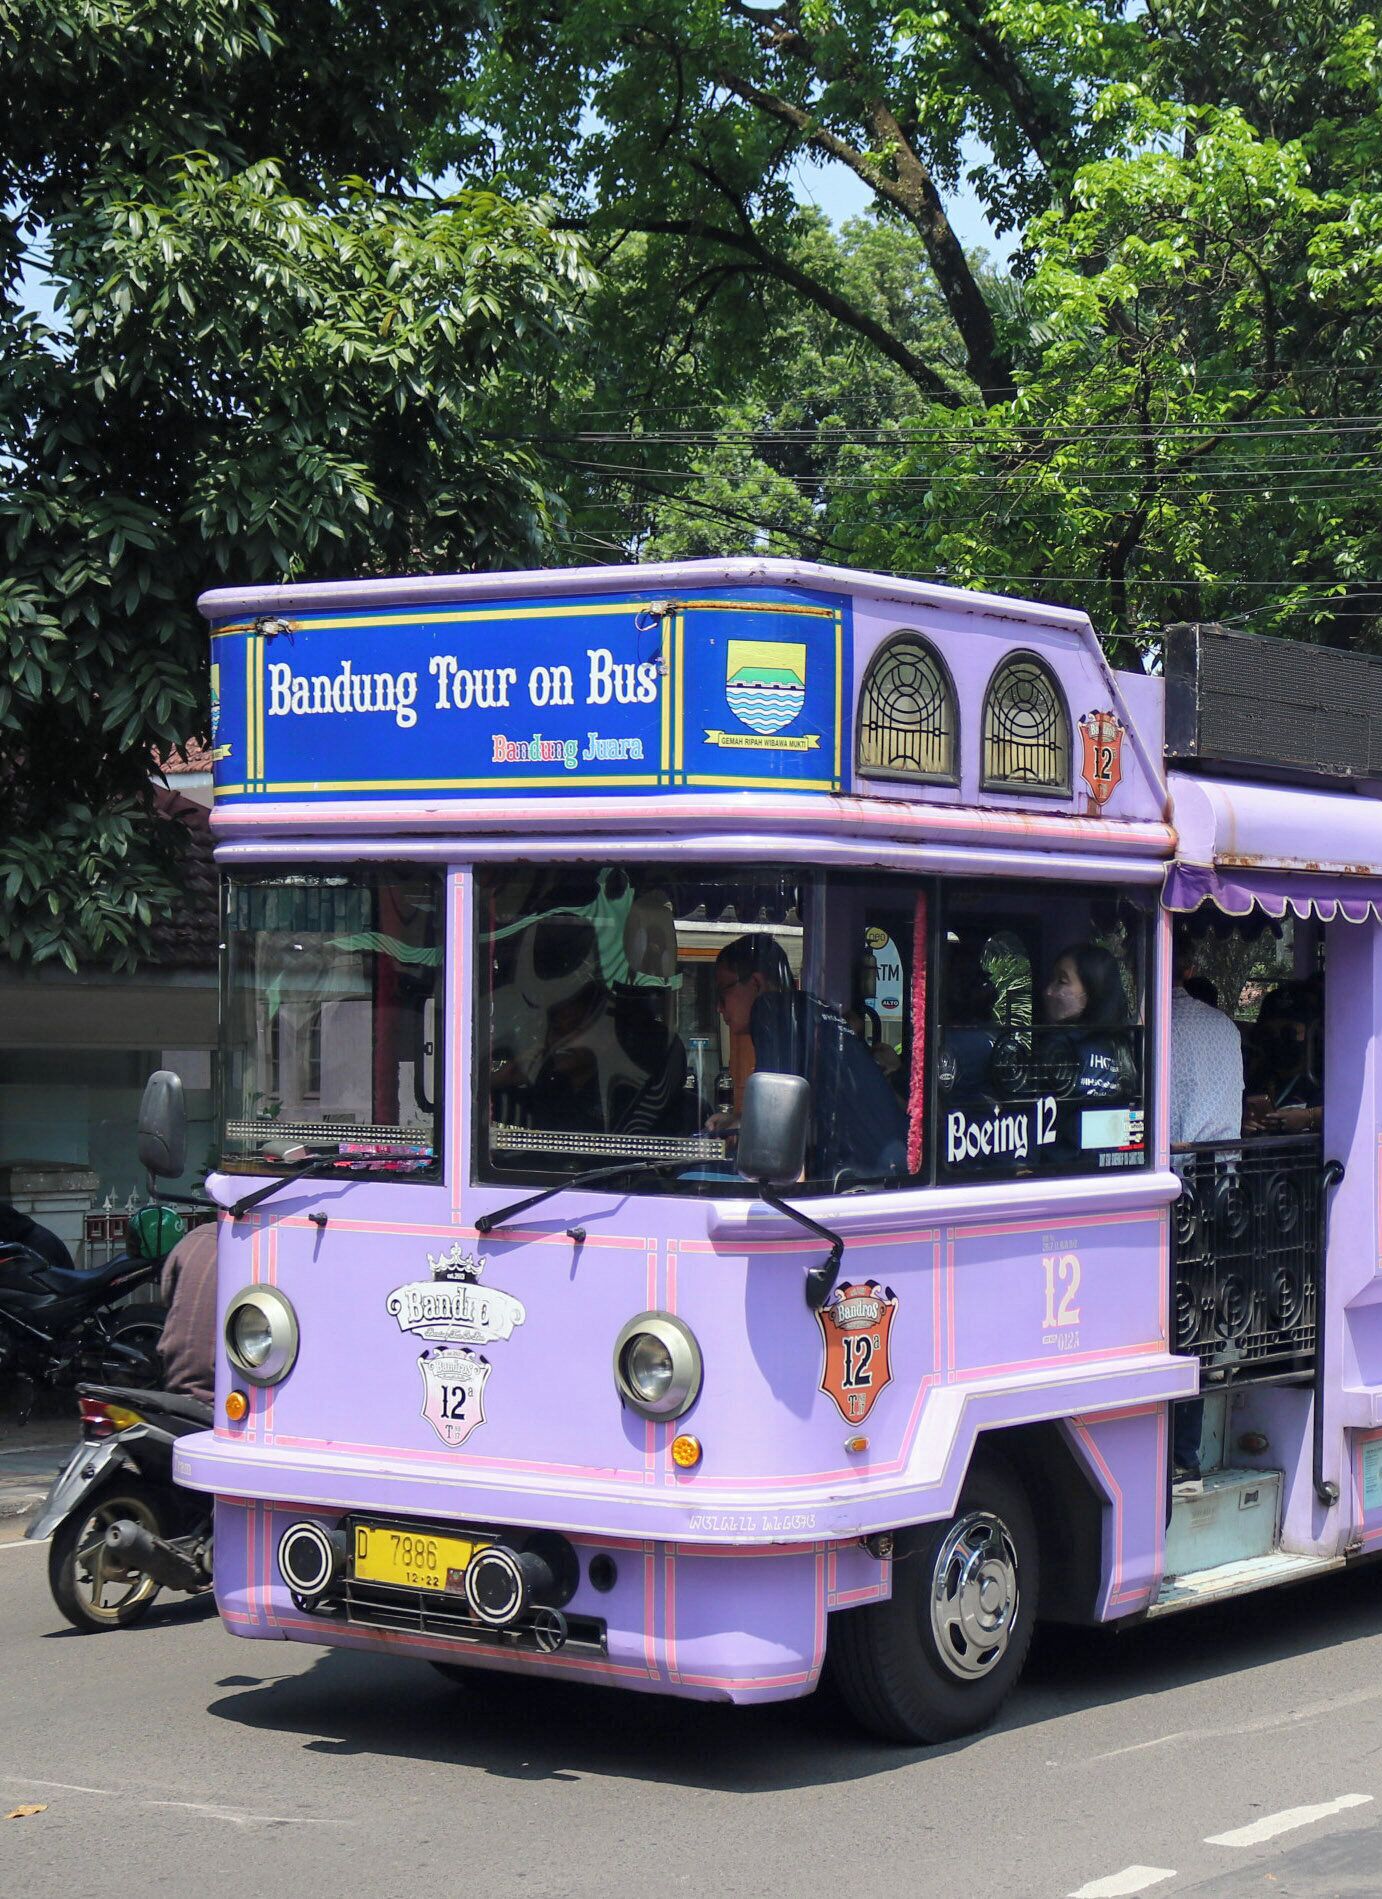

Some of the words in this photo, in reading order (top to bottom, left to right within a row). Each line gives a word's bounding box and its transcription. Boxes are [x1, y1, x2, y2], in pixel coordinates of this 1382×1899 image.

[267, 659, 418, 729] Bandung
[428, 655, 517, 709] Tour
[528, 665, 575, 707] on
[586, 648, 660, 705] Bus
[491, 733, 579, 770] Bandung
[582, 732, 644, 761] Juara
[721, 736, 743, 745] GEMAH
[744, 737, 763, 747] RIPAH
[764, 739, 787, 748] WIBAWA
[789, 740, 806, 749] MUKTI
[1093, 744, 1113, 781] 12
[948, 1104, 1028, 1162] Boeing
[1037, 1096, 1057, 1145] 12
[838, 1301, 879, 1320] Bandros
[1042, 1254, 1081, 1328] 12
[357, 1529, 368, 1559] D
[391, 1534, 438, 1570] 7886
